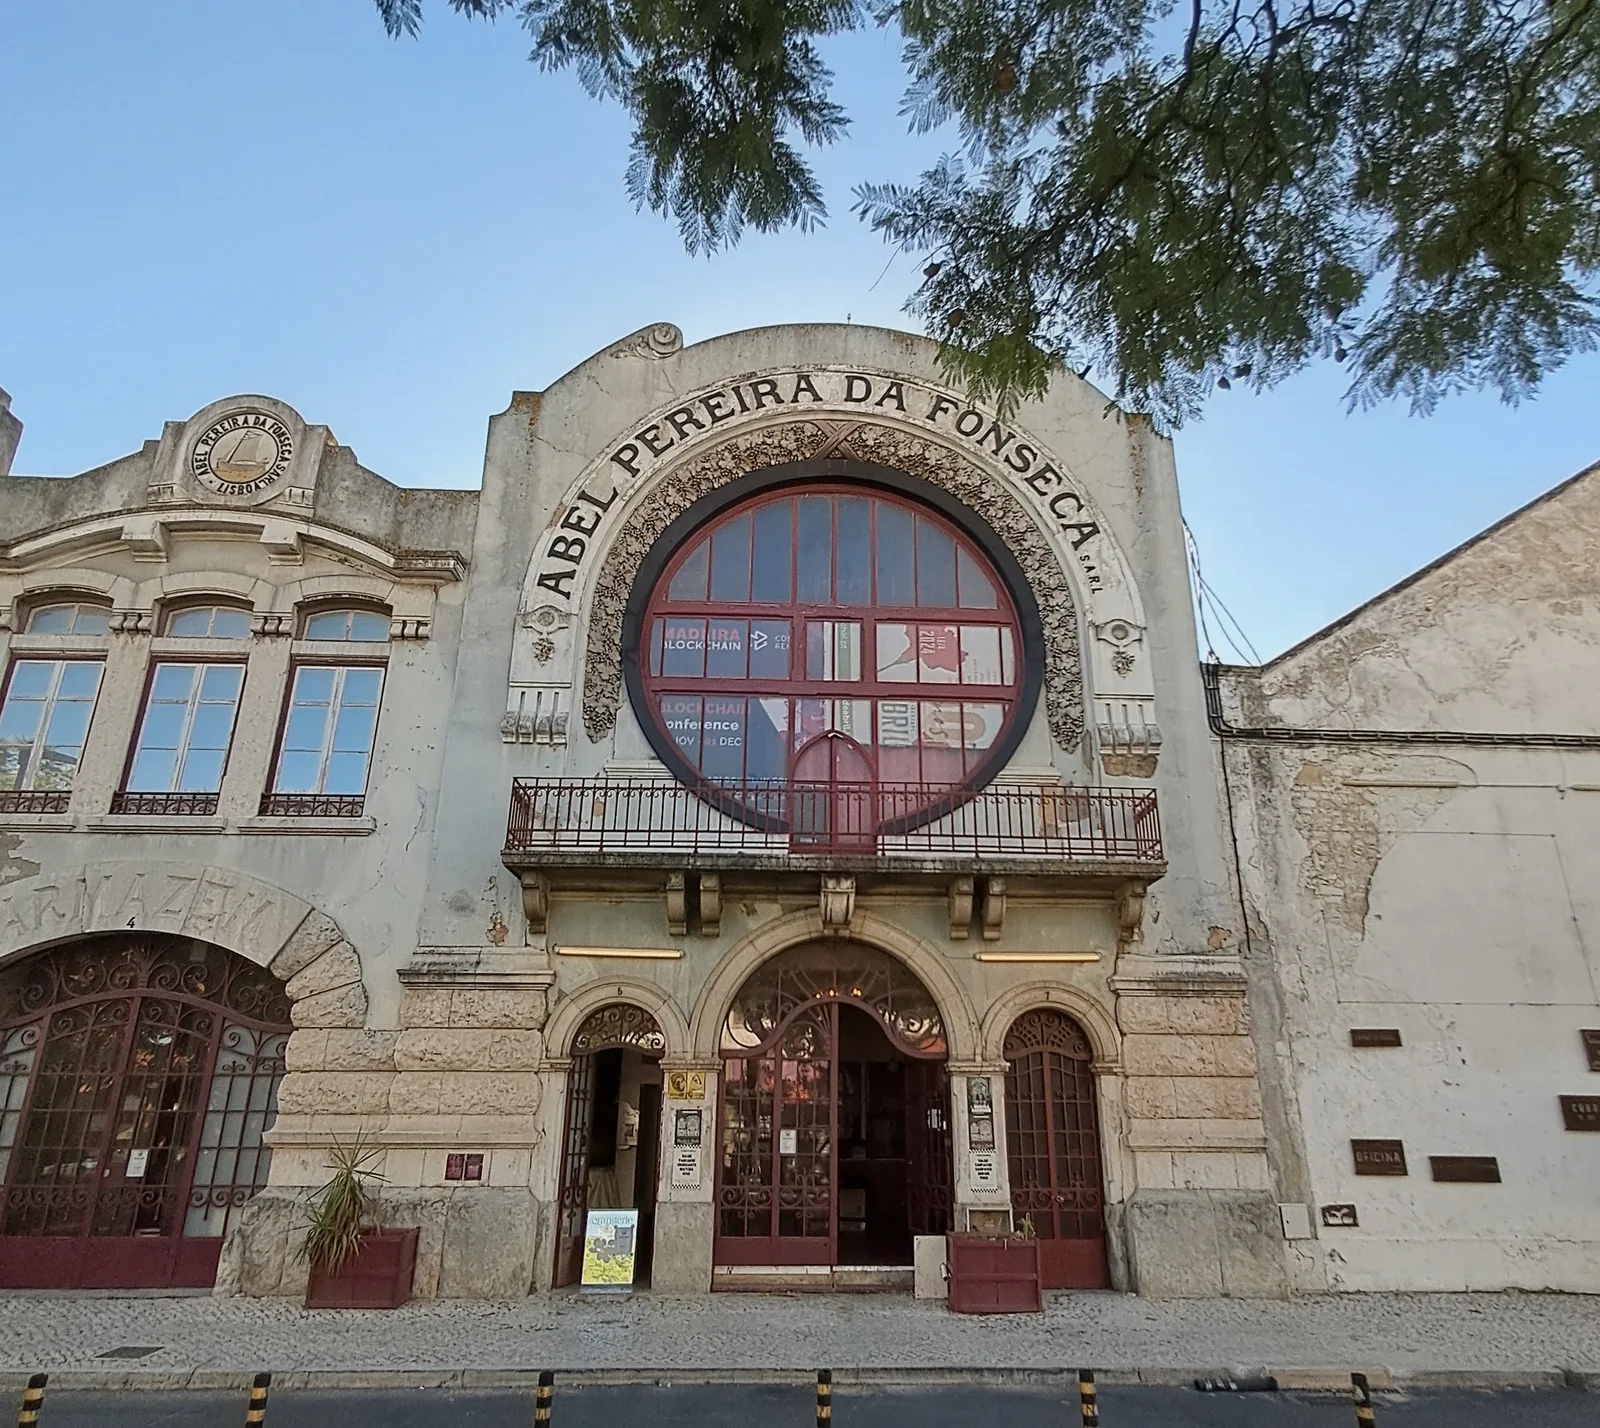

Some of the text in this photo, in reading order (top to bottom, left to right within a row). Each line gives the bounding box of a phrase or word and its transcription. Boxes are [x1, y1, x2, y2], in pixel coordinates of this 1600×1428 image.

[252, 416, 268, 428] DA
[201, 415, 249, 446] PEREIRA
[267, 421, 293, 462] FONSECA
[194, 450, 211, 477] ABEL
[216, 482, 262, 496] LISBOA
[537, 374, 1101, 600] ABEL PEREIRA DA FONSECA
[919, 630, 936, 654] 2024
[666, 719, 740, 730] onfeence
[719, 736, 742, 747] DEC
[126, 916, 136, 928] 4
[1355, 1151, 1401, 1163] OFICINA
